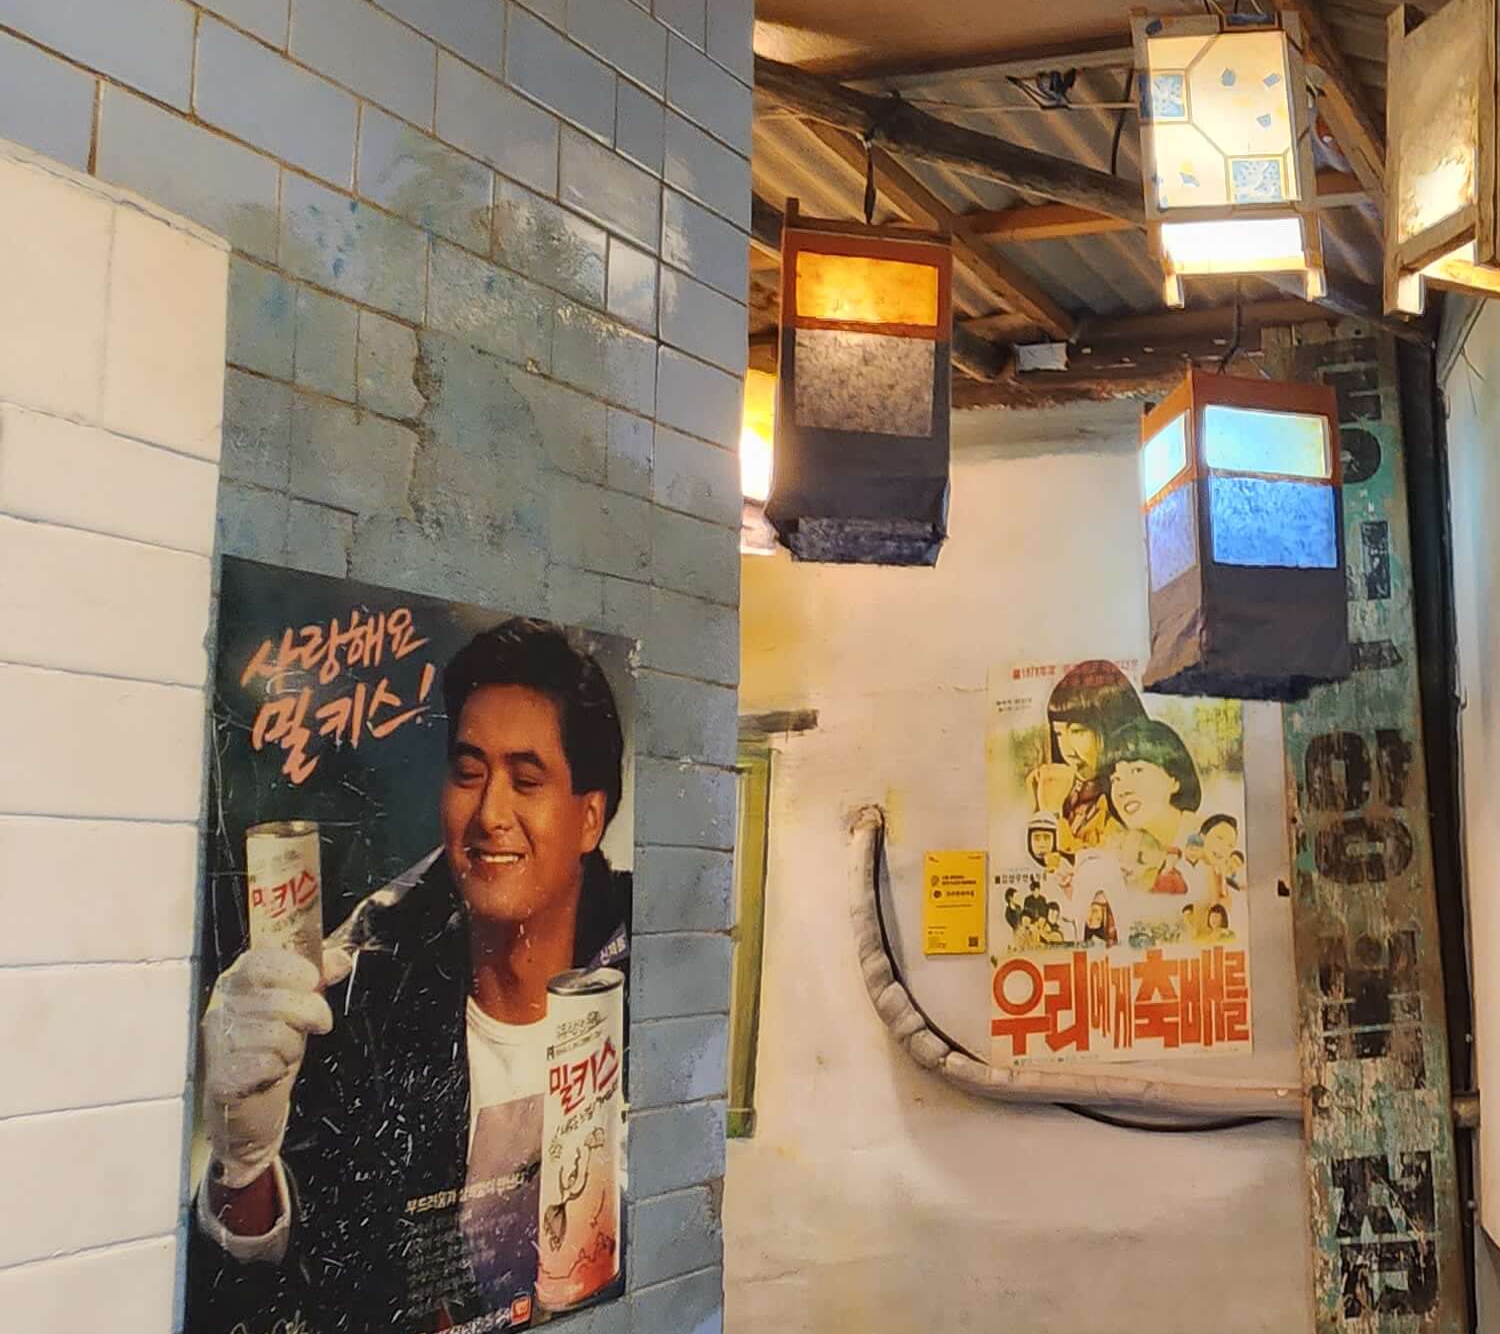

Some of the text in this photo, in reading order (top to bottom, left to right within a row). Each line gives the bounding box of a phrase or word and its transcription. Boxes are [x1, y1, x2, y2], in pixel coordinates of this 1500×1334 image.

[240, 607, 429, 694] 사랑해요
[252, 662, 434, 784] 밀키스!
[549, 1038, 620, 1116] 밀키스
